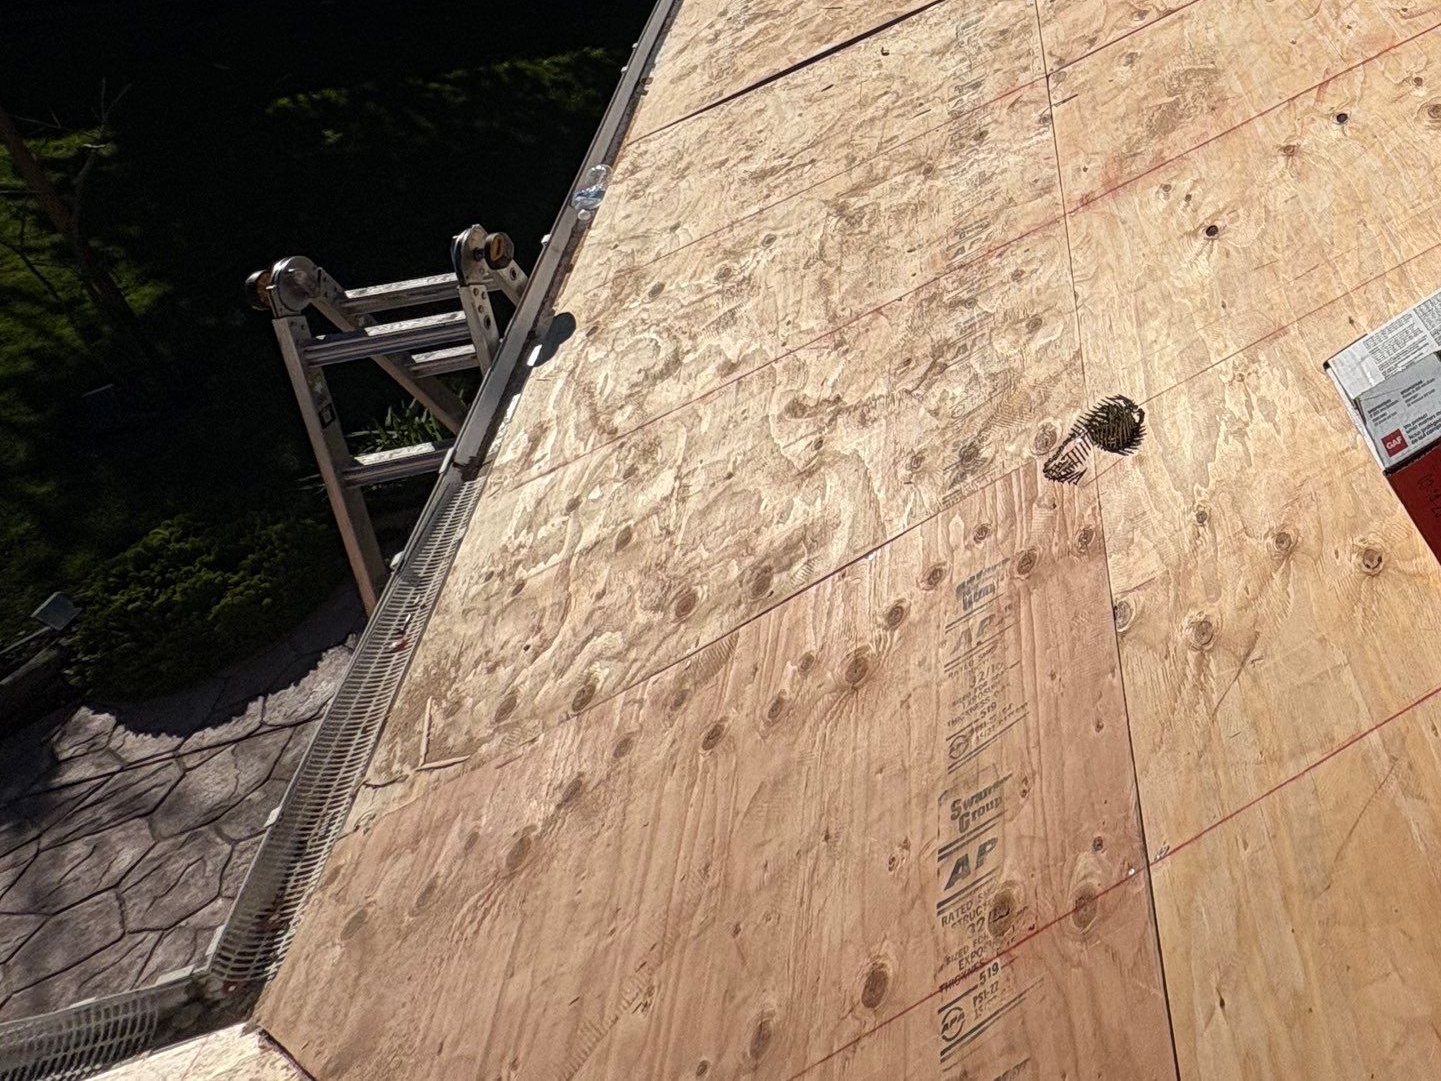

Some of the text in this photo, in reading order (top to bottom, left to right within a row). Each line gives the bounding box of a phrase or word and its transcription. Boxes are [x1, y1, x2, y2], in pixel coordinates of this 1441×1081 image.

[1386, 435, 1402, 450] GAF
[959, 797, 1002, 833] Group
[941, 901, 974, 928] RATED
[979, 961, 999, 986] 519
